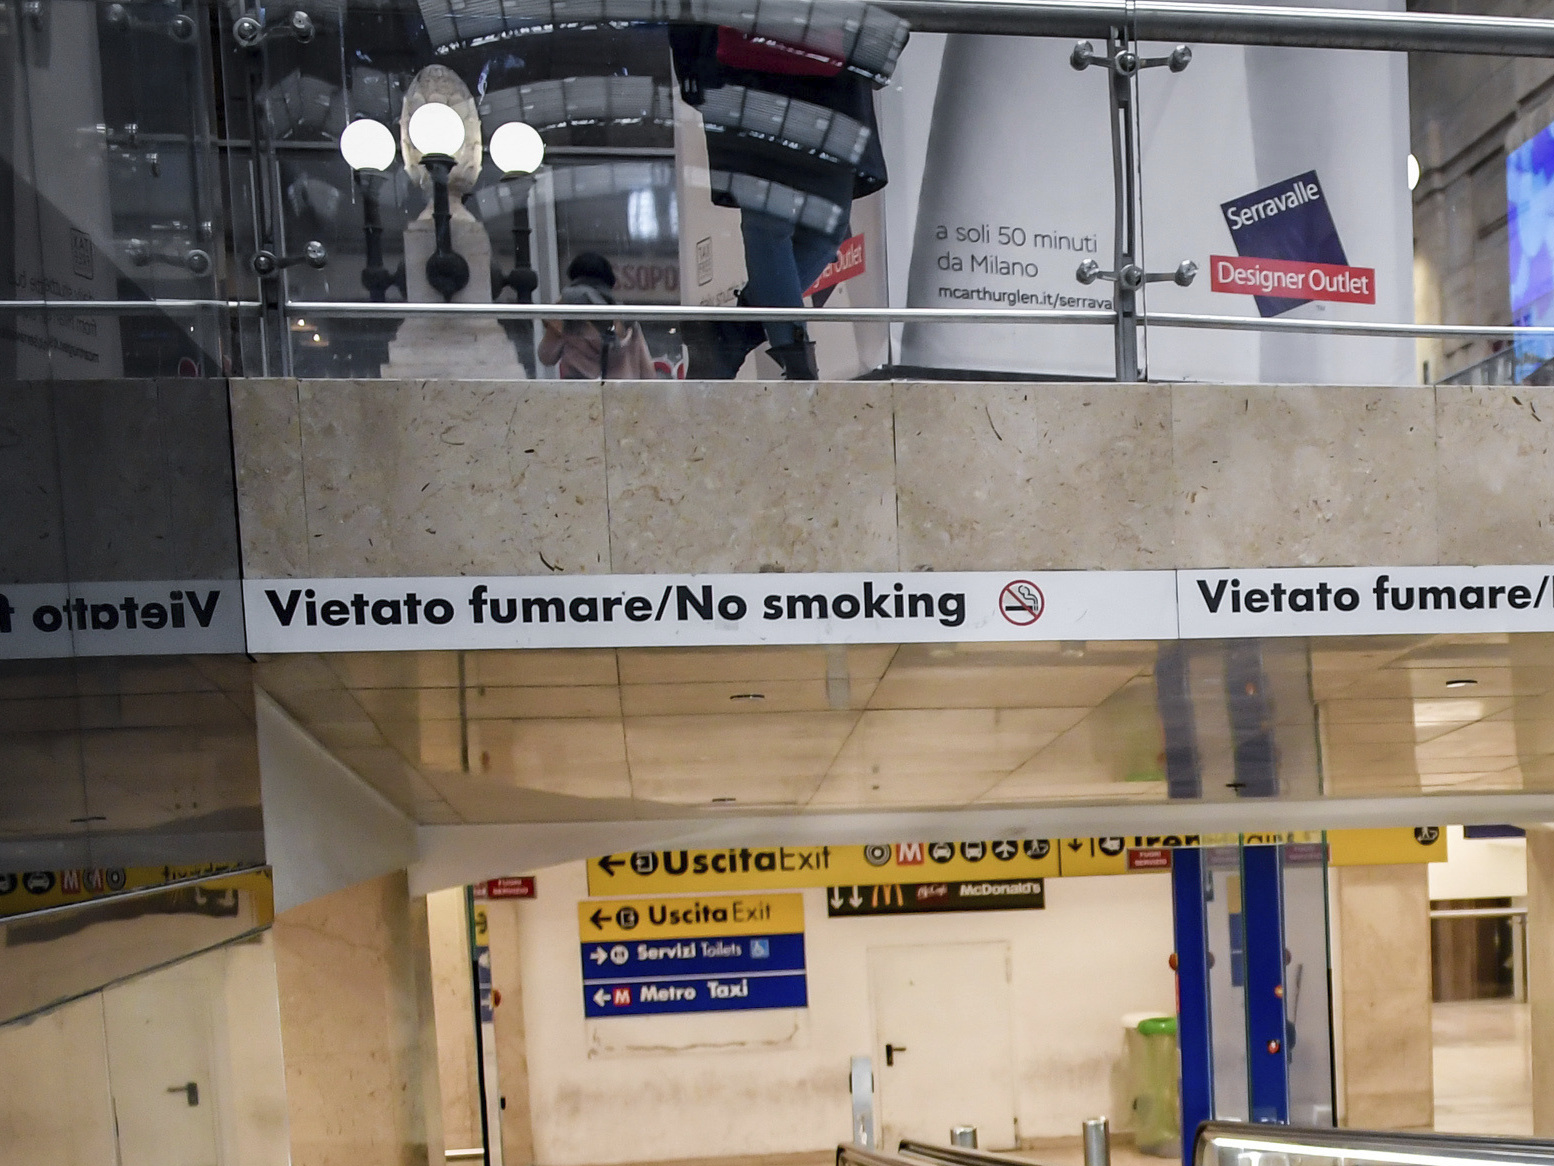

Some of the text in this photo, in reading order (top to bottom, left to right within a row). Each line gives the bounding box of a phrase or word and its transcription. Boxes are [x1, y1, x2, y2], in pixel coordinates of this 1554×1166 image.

[1227, 181, 1320, 230] Serravalle
[936, 224, 1097, 252] a soli 50 minuti
[937, 252, 1039, 278] da Milano
[1217, 261, 1369, 294] Designer Outlet
[938, 286, 1113, 310] mcarthurglen.it/serrava
[264, 581, 966, 627] Vietato fumare/No smoking
[1197, 578, 1360, 613] Vietato
[663, 848, 777, 875] Uscita
[780, 846, 832, 871] Exit
[959, 882, 1041, 897] McDonald's
[648, 901, 771, 926] Uscita Exit
[637, 940, 742, 961] Servizi Toilets
[640, 984, 697, 1003] Metro
[707, 979, 748, 999] Taxi
